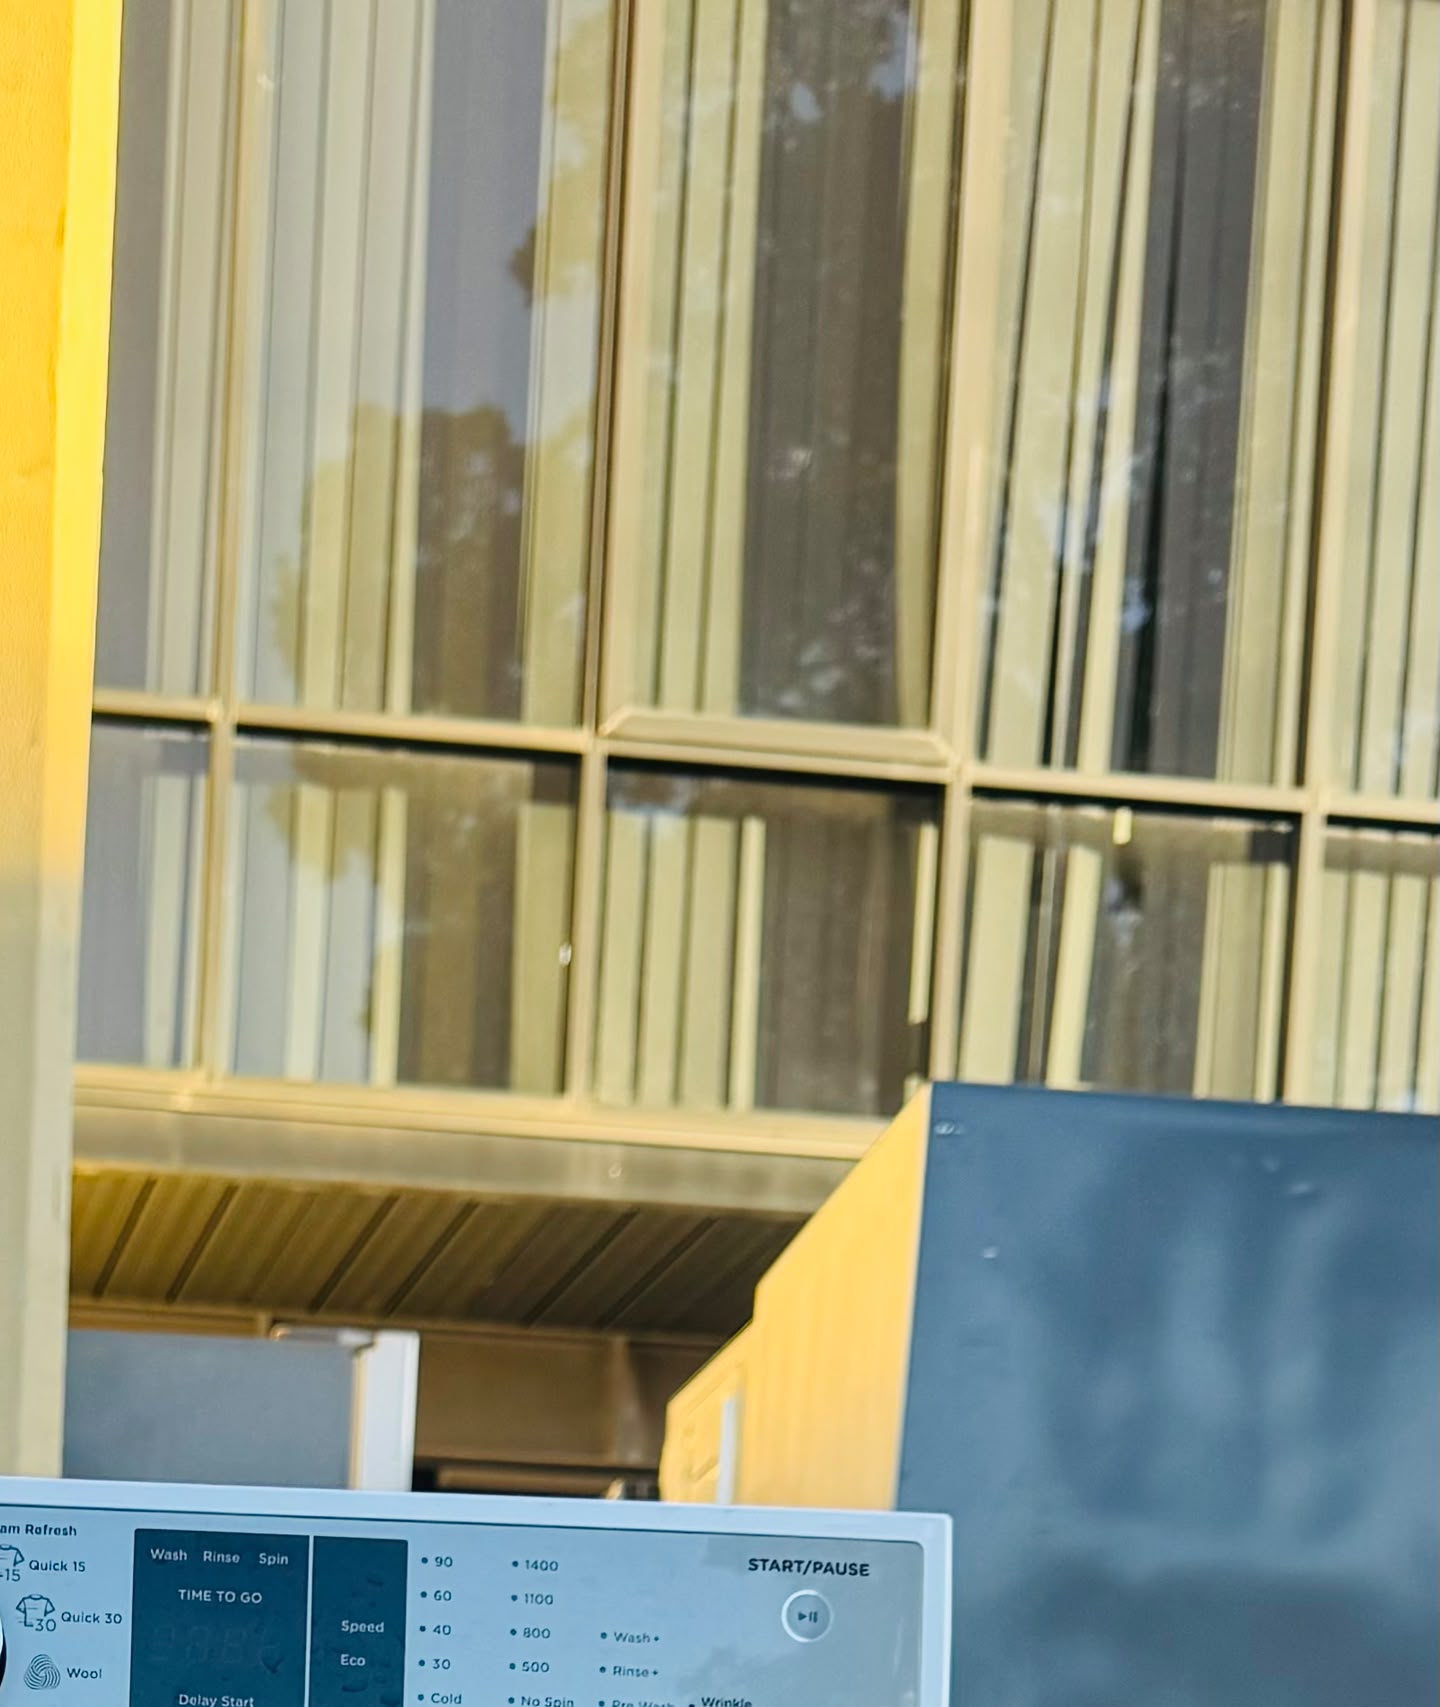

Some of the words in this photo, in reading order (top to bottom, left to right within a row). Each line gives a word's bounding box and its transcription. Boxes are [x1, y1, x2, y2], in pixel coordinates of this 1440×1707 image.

[25, 1524, 77, 1536] Refresh
[150, 1548, 187, 1561] Wash
[203, 1550, 240, 1563] Rinse
[259, 1553, 288, 1566] Spin
[434, 1556, 453, 1568] 90
[29, 1560, 68, 1571] Quick
[73, 1561, 85, 1572] 15
[525, 1560, 558, 1572] 1400
[748, 1558, 870, 1576] START/PAUSE
[6, 1569, 21, 1582] 15
[178, 1589, 211, 1602] TIME
[216, 1591, 236, 1603] TO
[240, 1592, 262, 1603] GO
[433, 1590, 452, 1601] 60
[524, 1593, 554, 1605] 1100
[61, 1612, 100, 1624] Quick
[105, 1613, 122, 1624] 30
[35, 1619, 57, 1632] 30
[341, 1620, 384, 1634] Speed
[433, 1625, 452, 1636] 40
[523, 1627, 551, 1639] 800
[340, 1654, 366, 1667] Eco
[432, 1659, 451, 1670] 30
[521, 1661, 549, 1673] 500
[66, 1668, 102, 1679] Wool
[178, 1694, 217, 1707] Delay
[221, 1695, 254, 1707] Start
[431, 1692, 462, 1705] Cold
[521, 1696, 540, 1707] No
